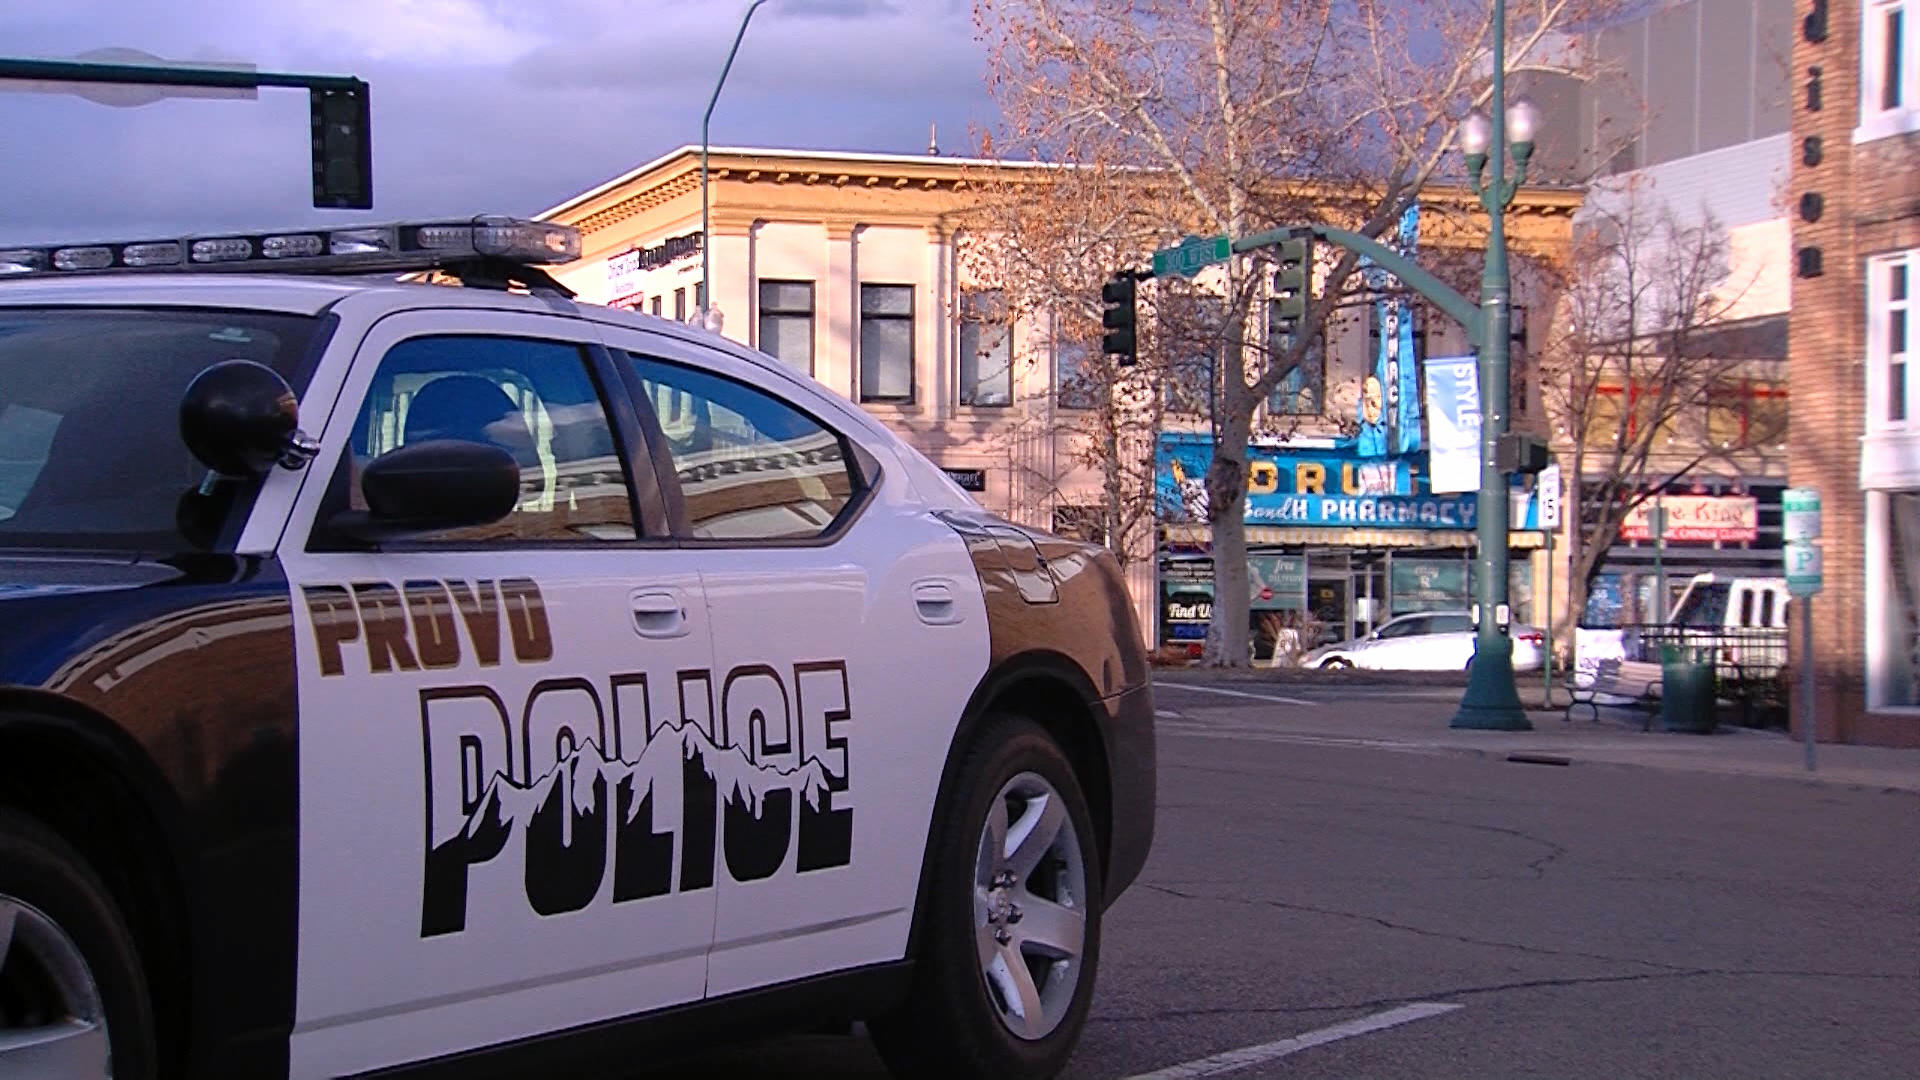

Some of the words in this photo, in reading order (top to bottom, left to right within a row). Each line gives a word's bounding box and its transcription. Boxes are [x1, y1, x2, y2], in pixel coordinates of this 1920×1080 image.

[1454, 363, 1480, 426] STYLE
[1322, 498, 1475, 524] PHARMACY
[1695, 501, 1744, 527] King
[1796, 552, 1813, 570] P
[1168, 603, 1197, 618] Find
[300, 577, 554, 677] PROVO
[418, 659, 854, 938] POLICE
